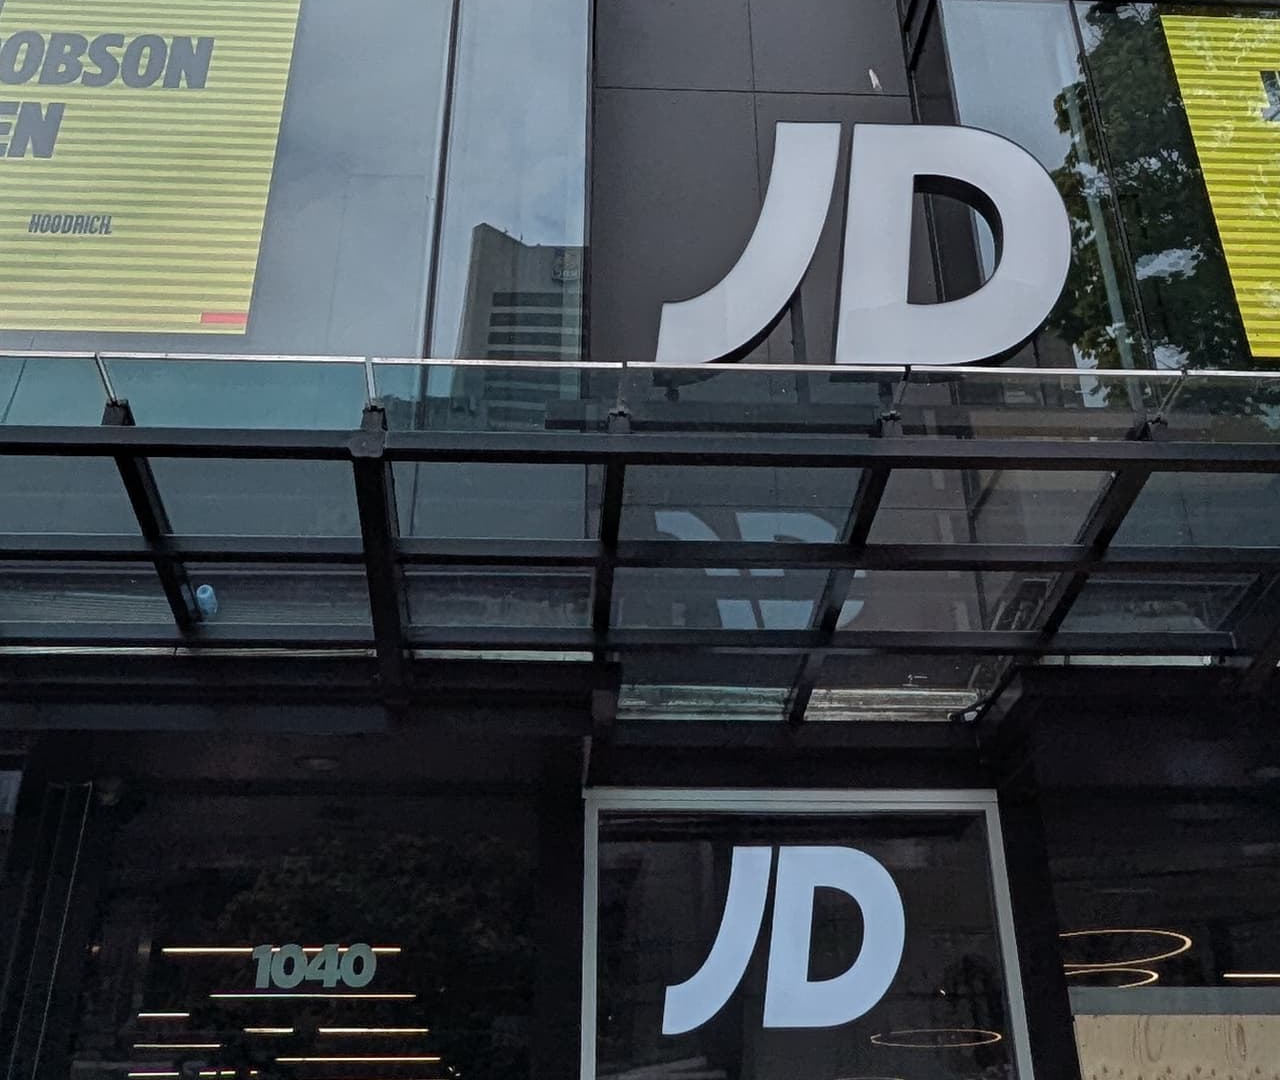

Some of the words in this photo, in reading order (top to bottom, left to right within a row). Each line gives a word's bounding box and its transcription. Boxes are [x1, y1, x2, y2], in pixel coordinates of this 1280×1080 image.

[27, 213, 113, 235] HOODRICH
[655, 122, 1072, 365] JD
[252, 943, 377, 989] 1040
[662, 845, 907, 1036] JD
